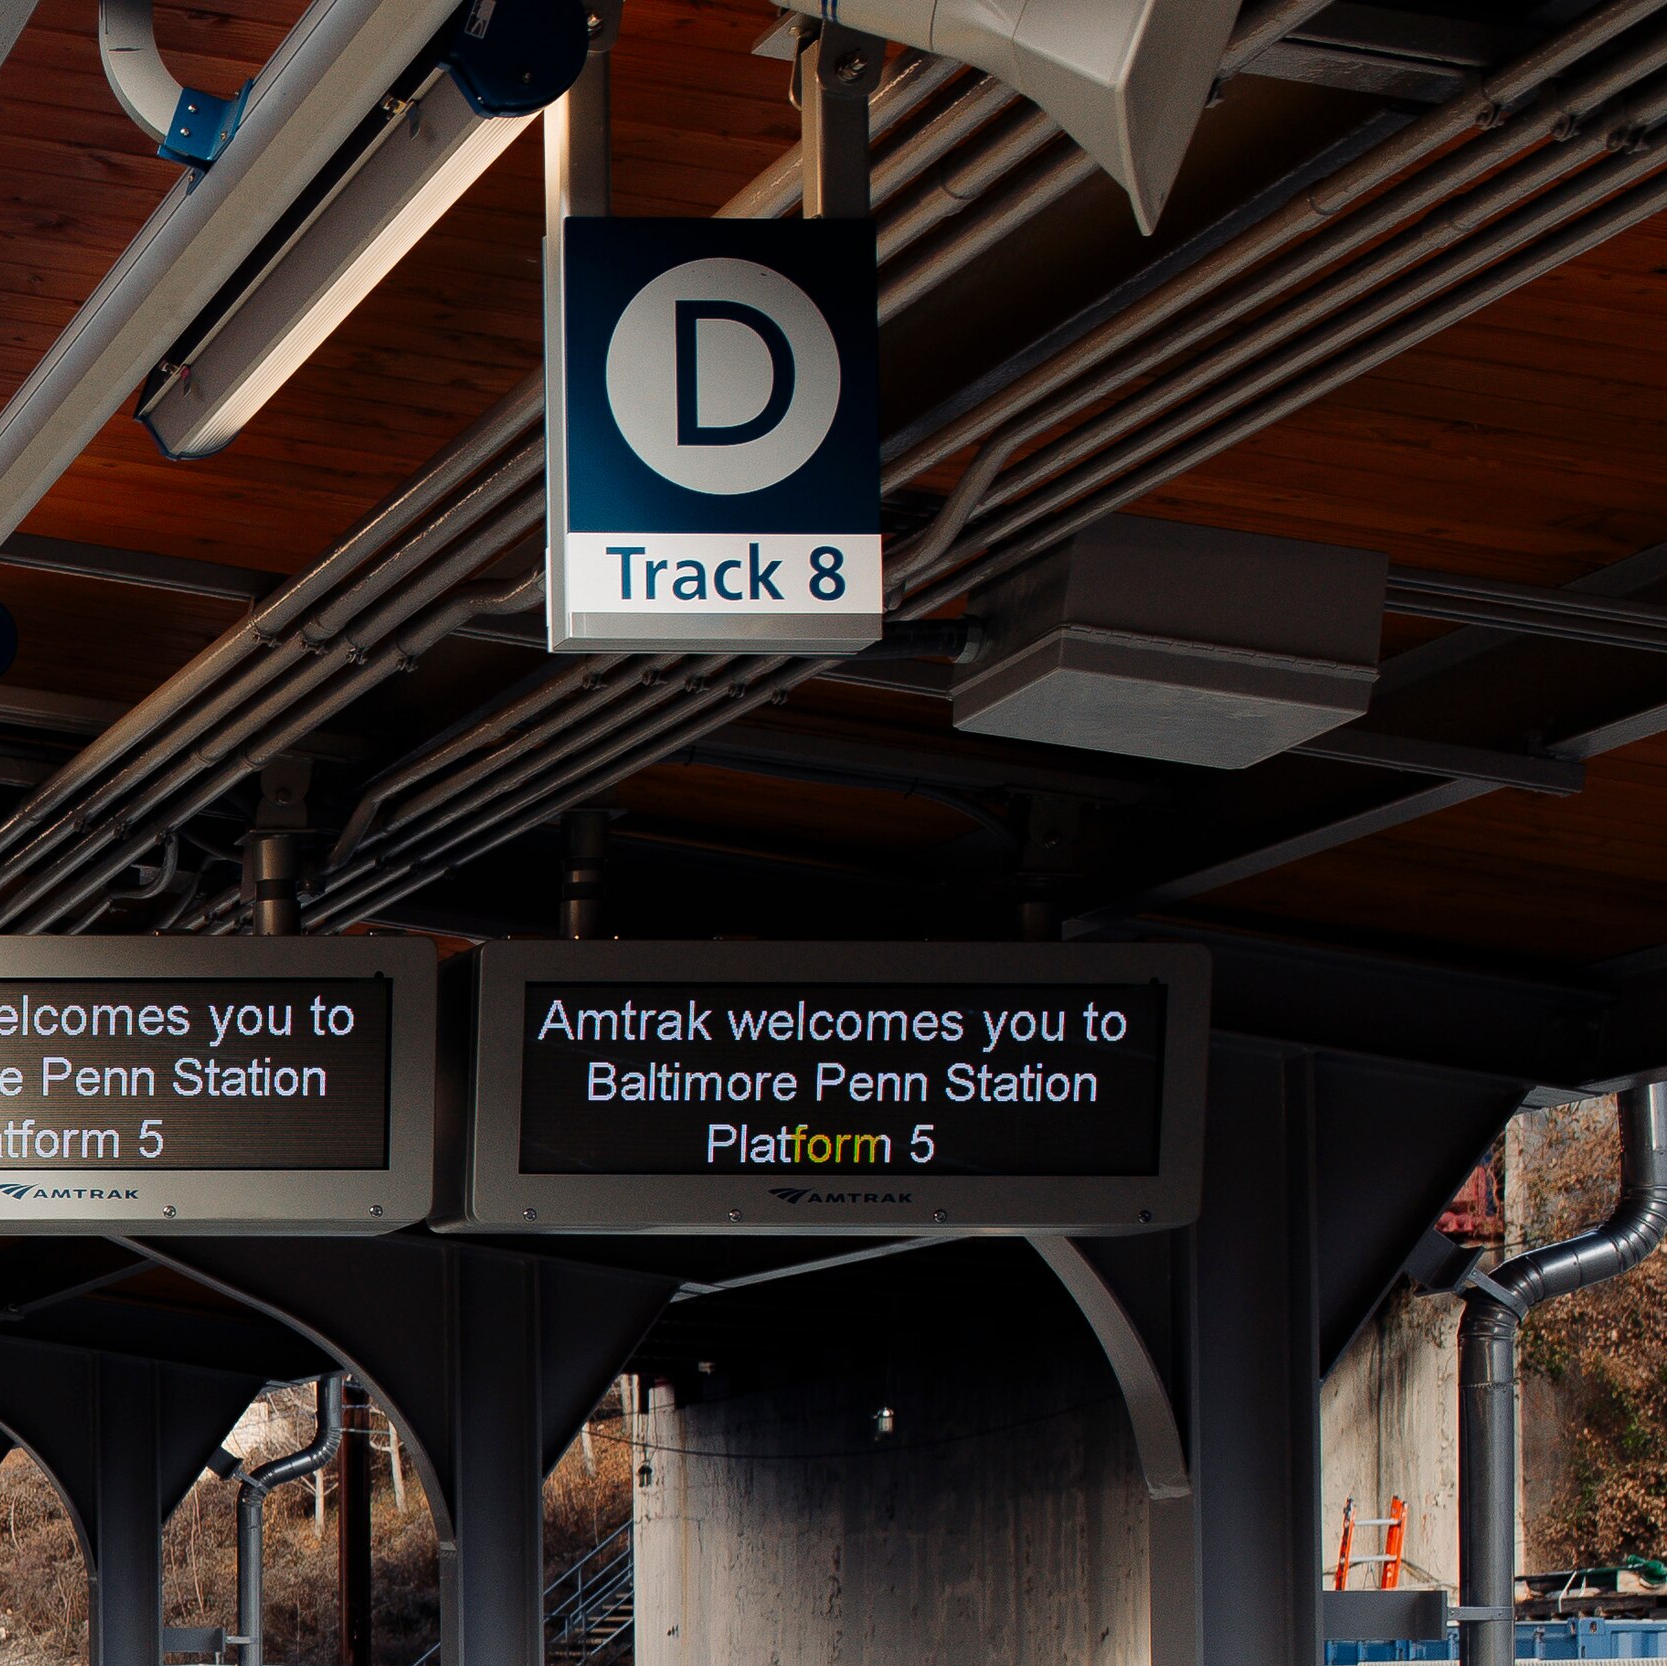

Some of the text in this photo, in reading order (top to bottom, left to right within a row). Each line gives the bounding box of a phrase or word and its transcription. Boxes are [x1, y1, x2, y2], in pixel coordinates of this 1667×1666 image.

[674, 299, 796, 447] D
[605, 542, 847, 602] Track 8
[208, 1005, 292, 1047] you
[310, 996, 354, 1036] to
[537, 1000, 1127, 1053] Amtrak welcomes you to
[42, 1057, 155, 1097] Penn
[172, 1057, 327, 1097] Station
[587, 1061, 1097, 1102] Baltimore Penn Station
[139, 1119, 164, 1158] 5
[707, 1123, 935, 1163] Platform 5
[33, 1188, 140, 1200] AMTRAK
[807, 1192, 913, 1204] AMTRAK
